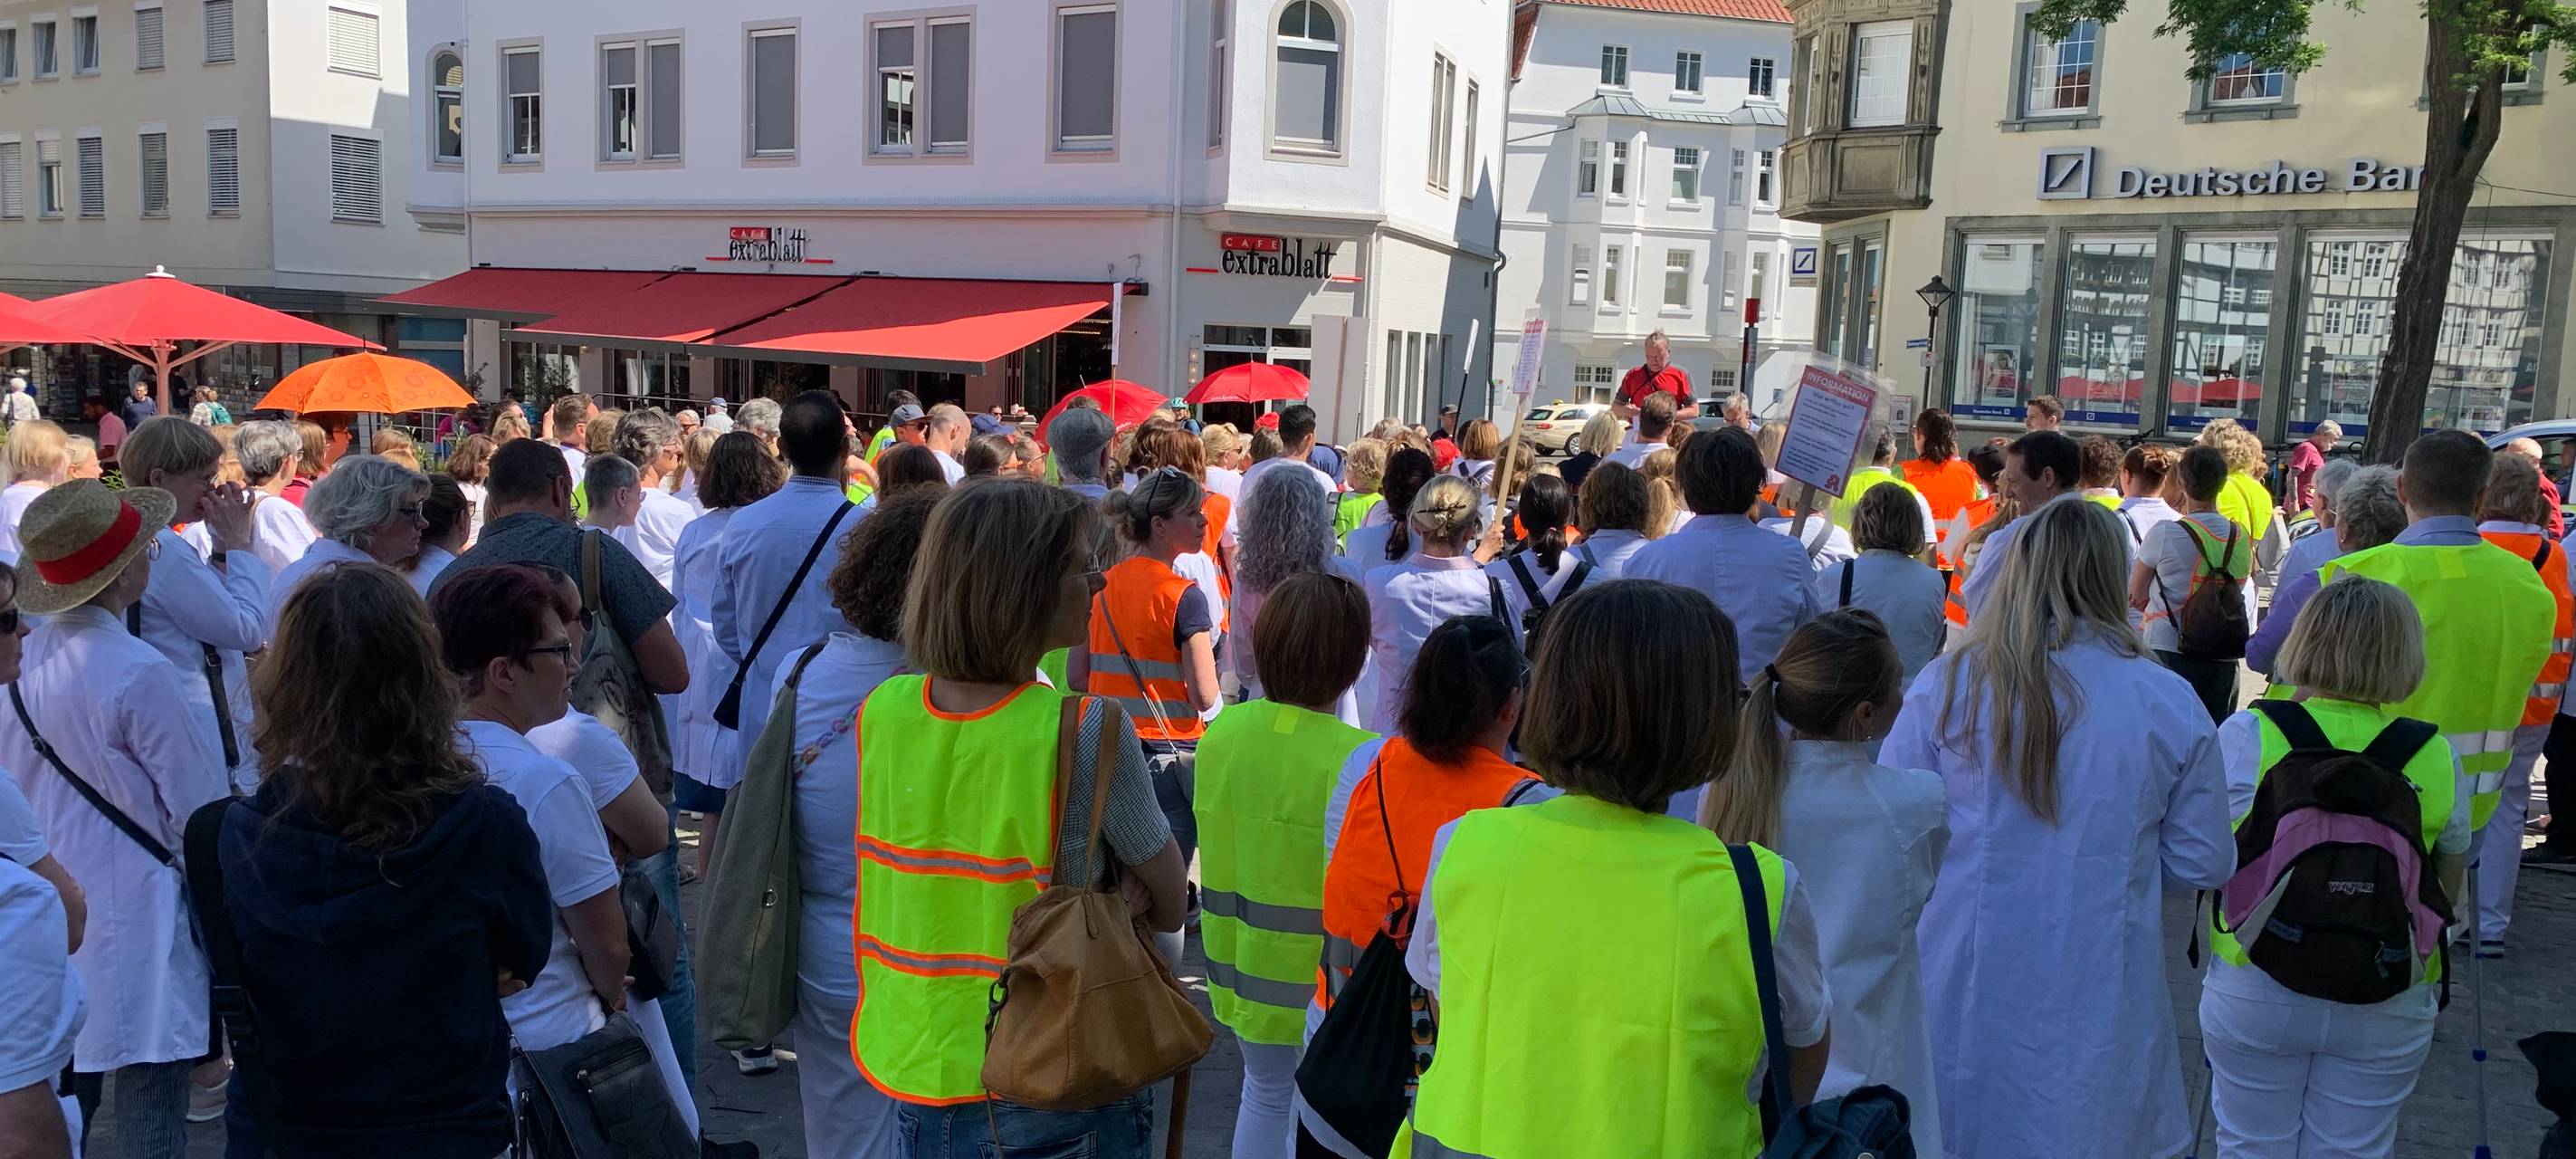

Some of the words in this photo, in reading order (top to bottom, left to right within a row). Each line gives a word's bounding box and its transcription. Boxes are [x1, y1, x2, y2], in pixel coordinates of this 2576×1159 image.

[2113, 160, 2324, 197] Deutsche
[2345, 158, 2424, 191] Ba
[730, 229, 767, 238] CAFE
[730, 227, 808, 263] extrablatt
[1225, 237, 1278, 250] CAFE
[1222, 237, 1337, 279] extrablatt
[1807, 371, 1869, 403] INFORMATION
